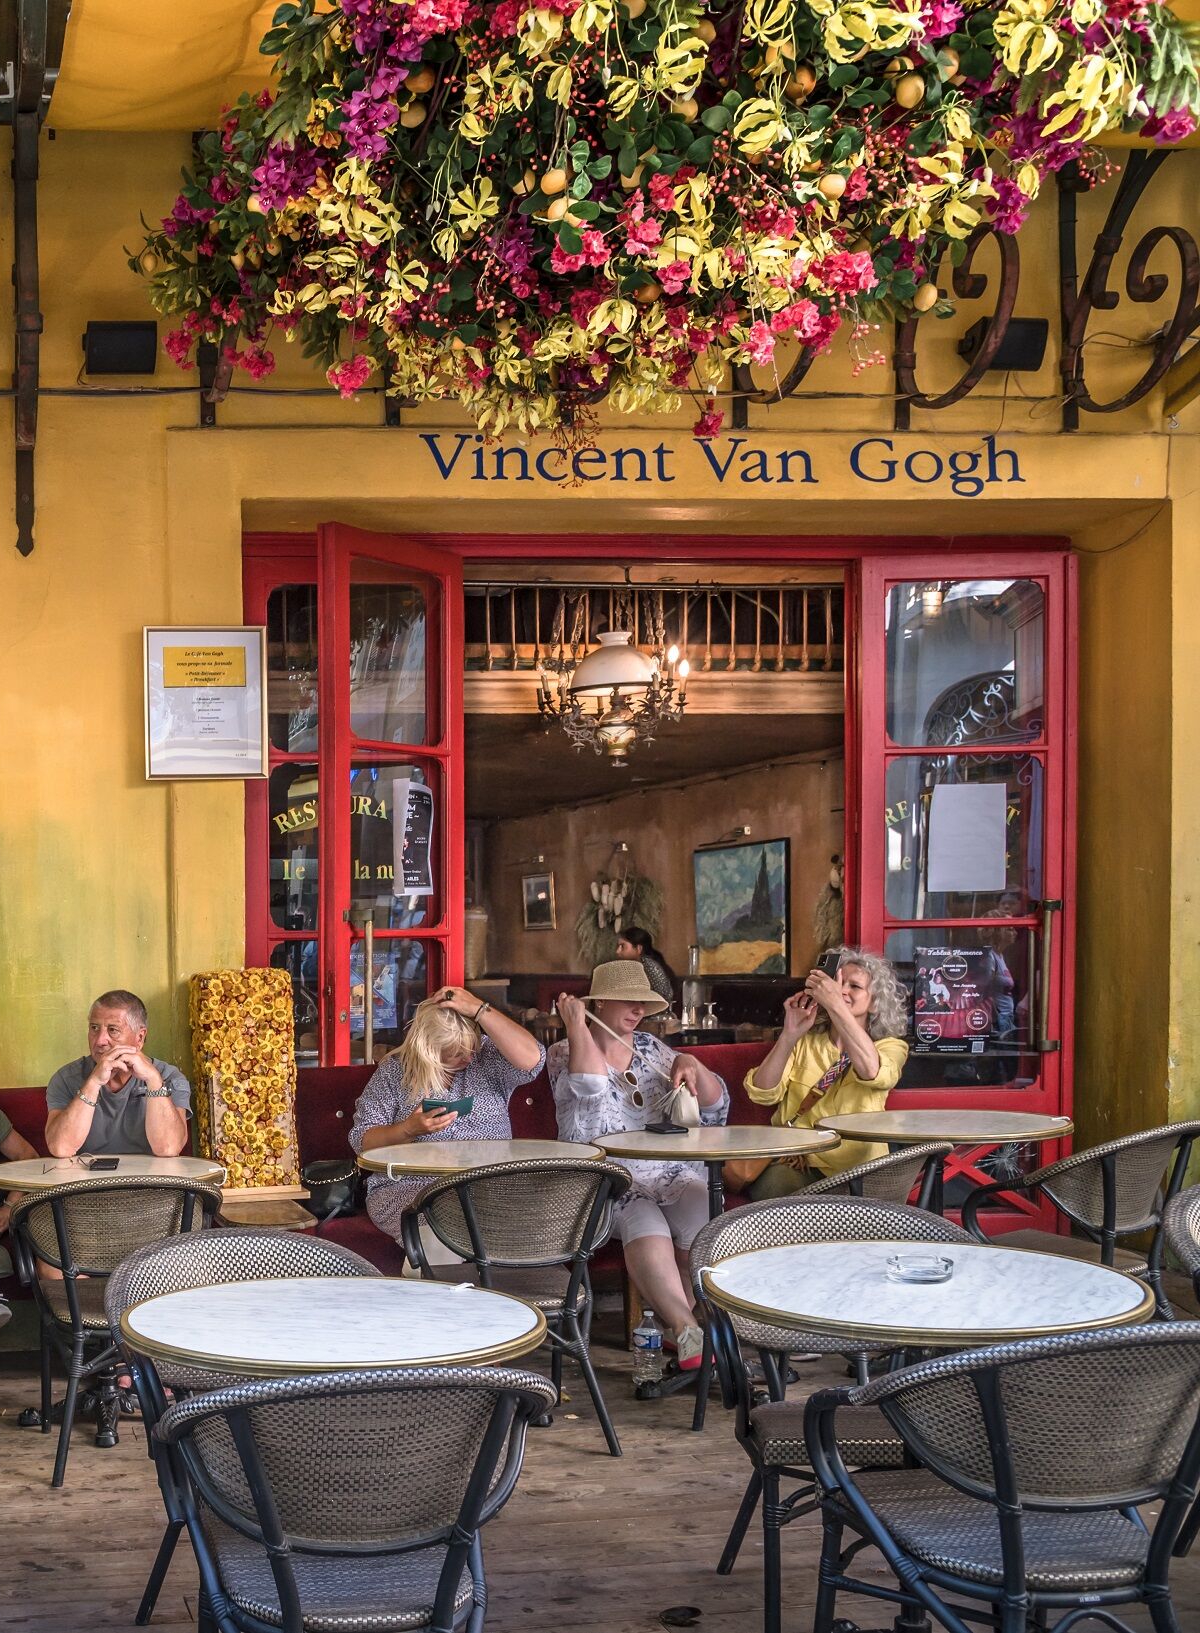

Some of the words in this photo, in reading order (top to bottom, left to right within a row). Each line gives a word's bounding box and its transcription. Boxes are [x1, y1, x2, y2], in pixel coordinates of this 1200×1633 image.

[419, 434, 675, 482] Vincent
[692, 437, 819, 483] Van
[849, 434, 1026, 497] Gogh
[354, 859, 371, 880] la
